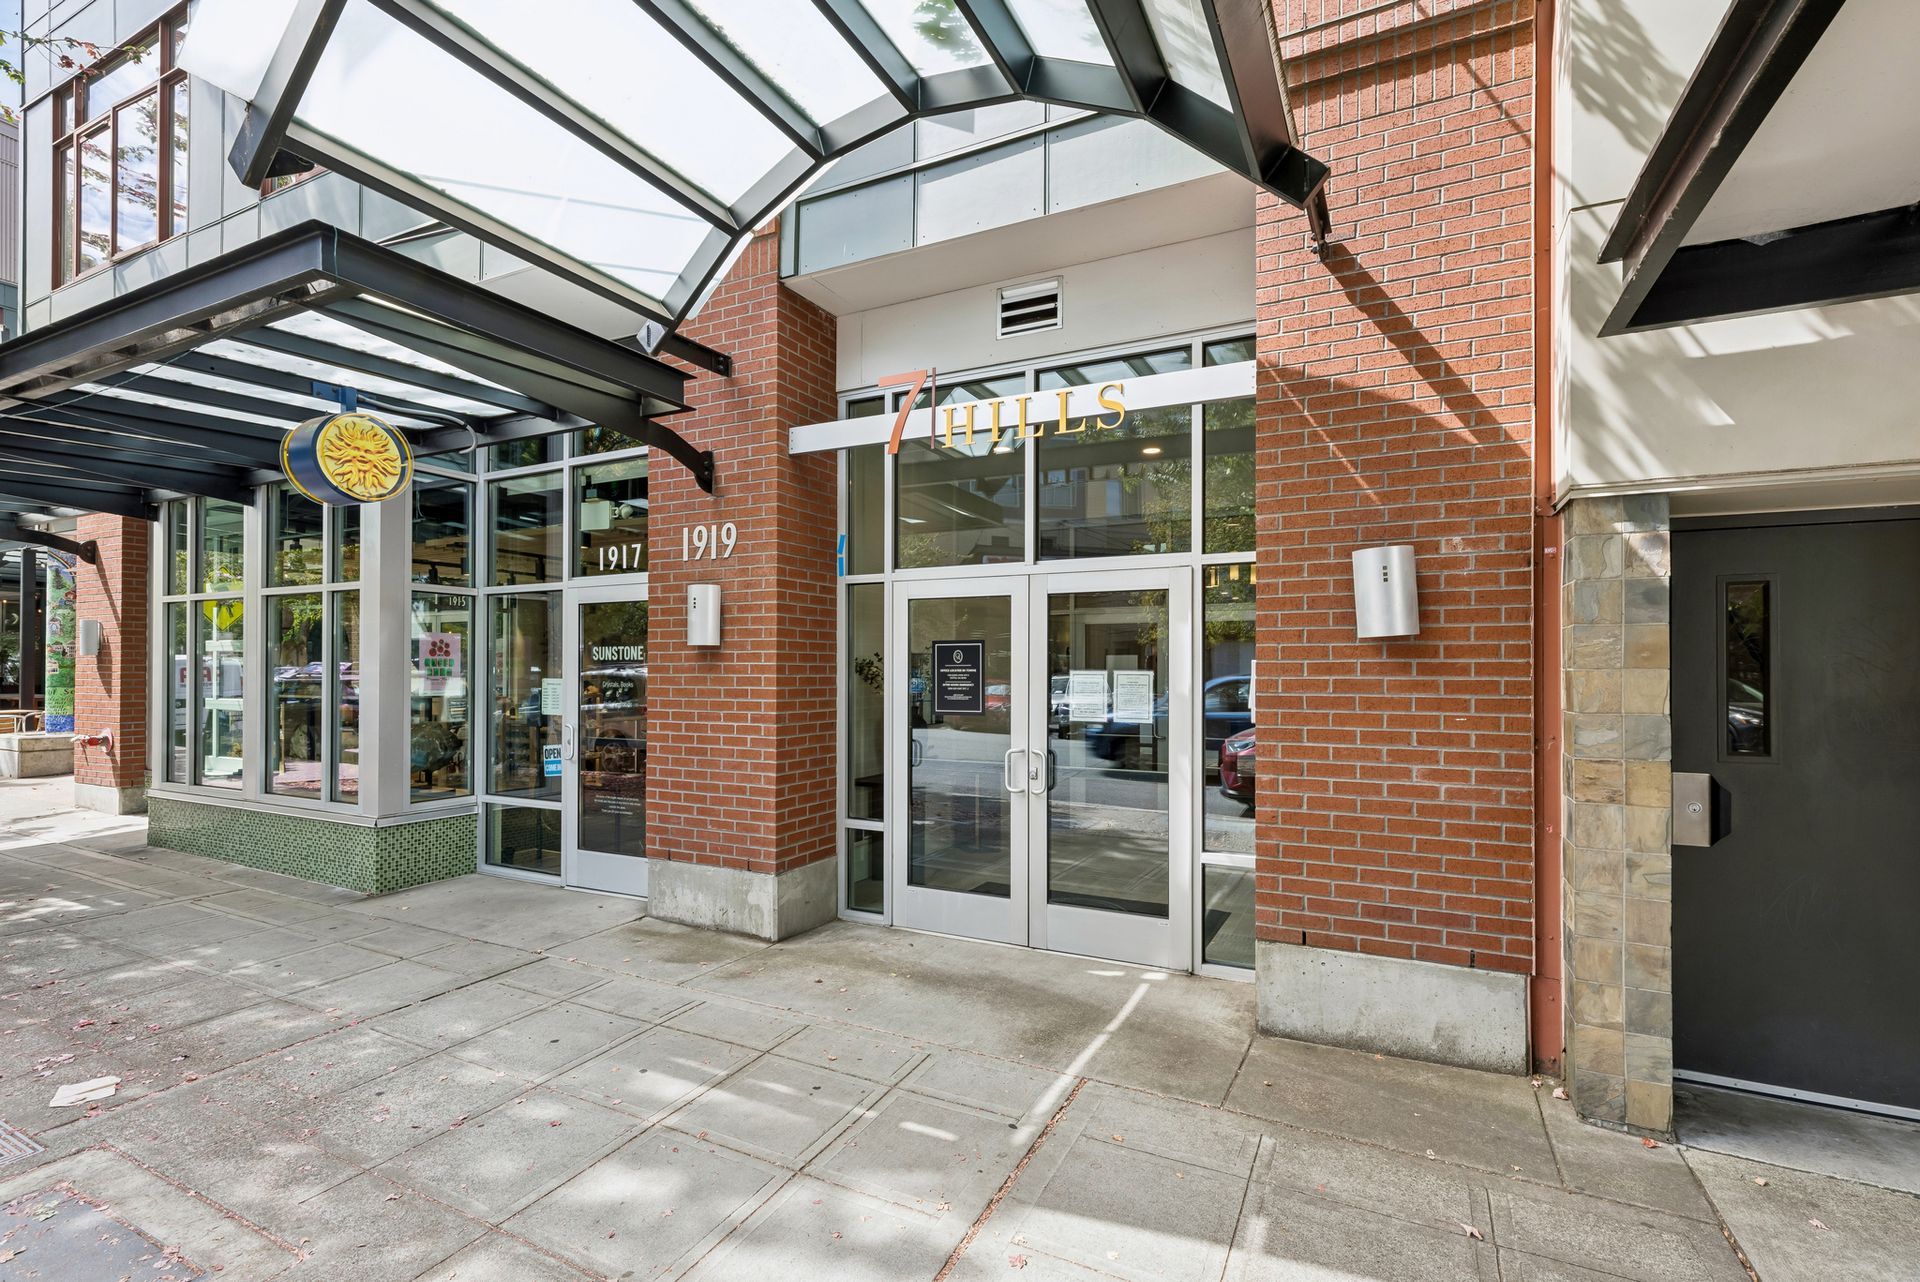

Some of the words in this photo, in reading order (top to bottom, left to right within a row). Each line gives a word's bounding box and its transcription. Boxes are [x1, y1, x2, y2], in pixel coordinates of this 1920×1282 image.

[878, 369, 928, 455] 7
[941, 383, 1126, 448] HILLS
[682, 522, 737, 562] 1919
[599, 543, 642, 571] 1917
[592, 645, 644, 661] SUNSTONE
[544, 748, 561, 759] OPEN
